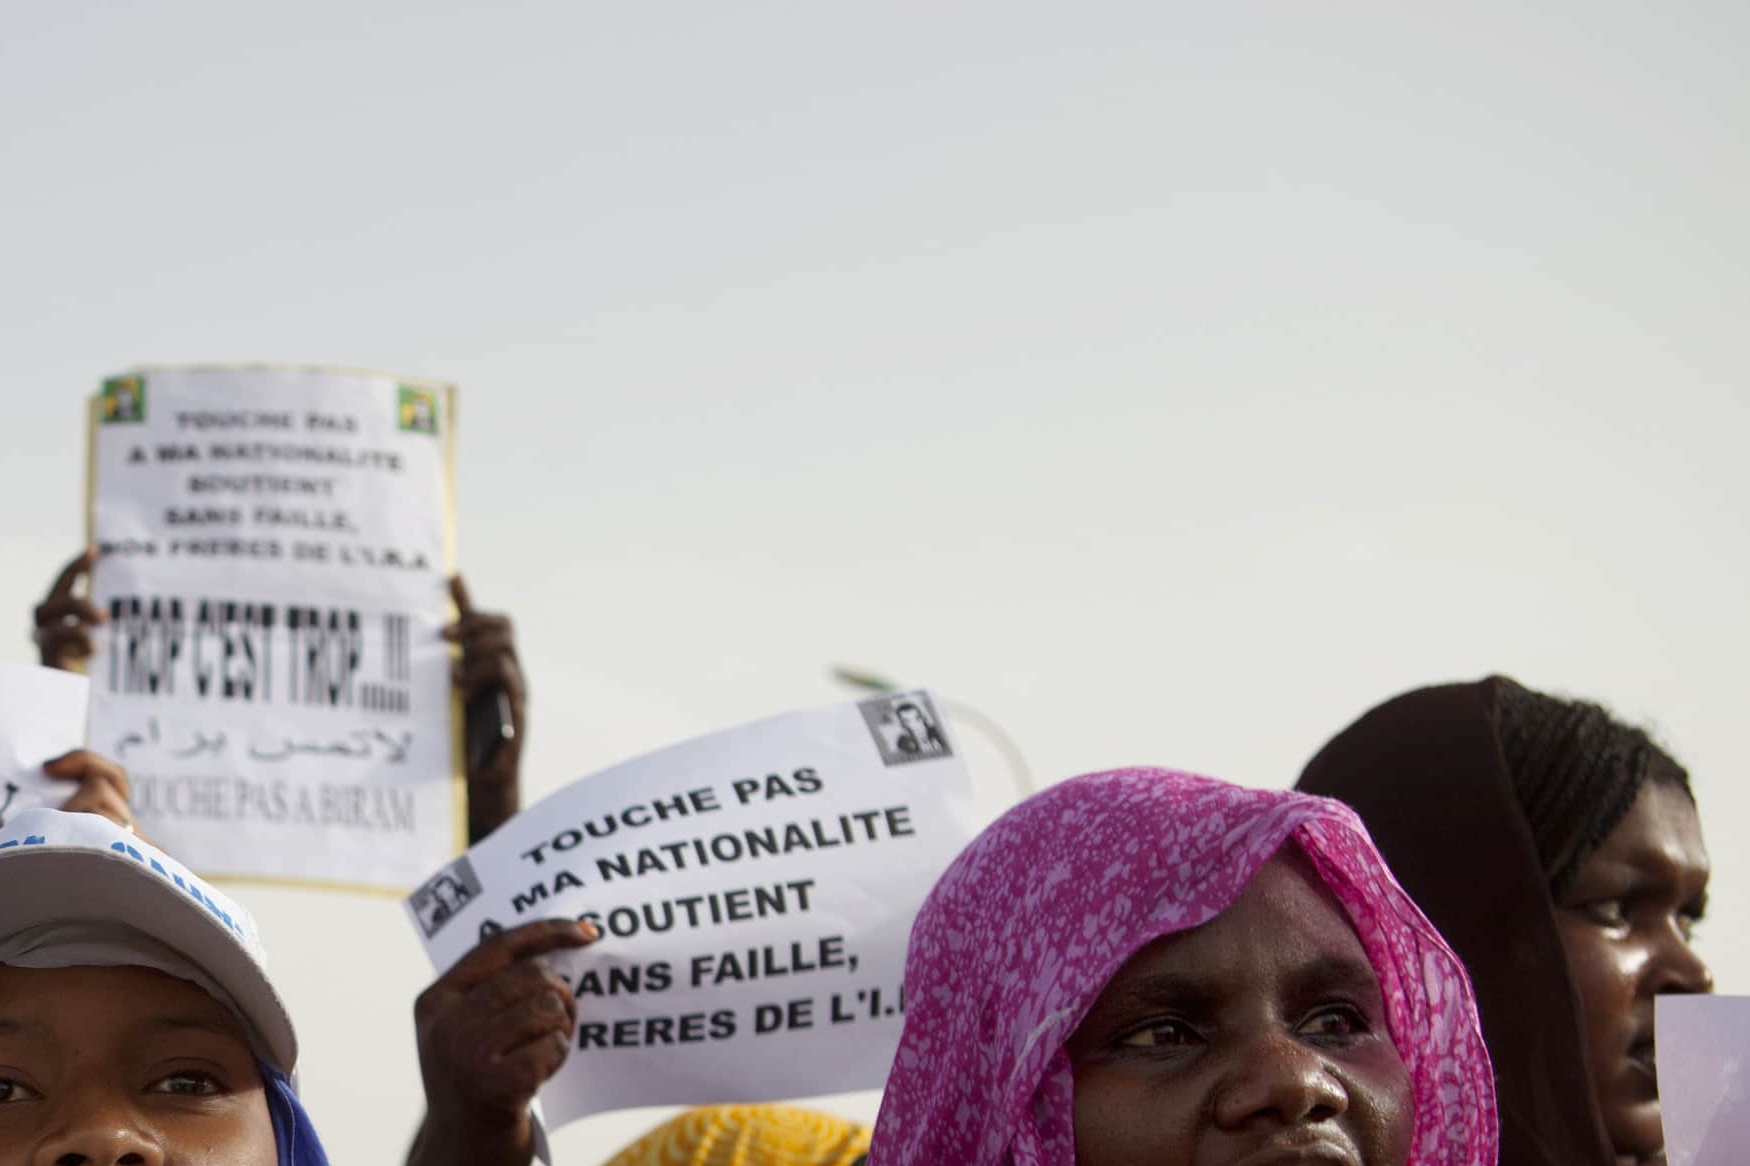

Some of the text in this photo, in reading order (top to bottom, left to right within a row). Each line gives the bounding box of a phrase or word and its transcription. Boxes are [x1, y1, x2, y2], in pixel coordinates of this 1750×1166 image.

[176, 410, 359, 433] TOUCHE PAS
[128, 444, 402, 470] A MA NATIONALITE
[188, 475, 336, 496] SOUTIENT
[165, 507, 243, 526] SANS
[292, 542, 328, 562] DE
[108, 597, 185, 695] TROP
[193, 597, 276, 702] C'EST
[234, 776, 291, 824] PAS
[296, 784, 317, 827] A
[318, 782, 416, 834] BIRAM
[520, 767, 825, 866] TOUCHE PAS
[510, 869, 584, 916] MA
[595, 805, 916, 883] NATIONALITE
[577, 879, 816, 941] SOUTIENT
[562, 935, 859, 998] ANS FAILLE,
[754, 996, 815, 1036] DE
